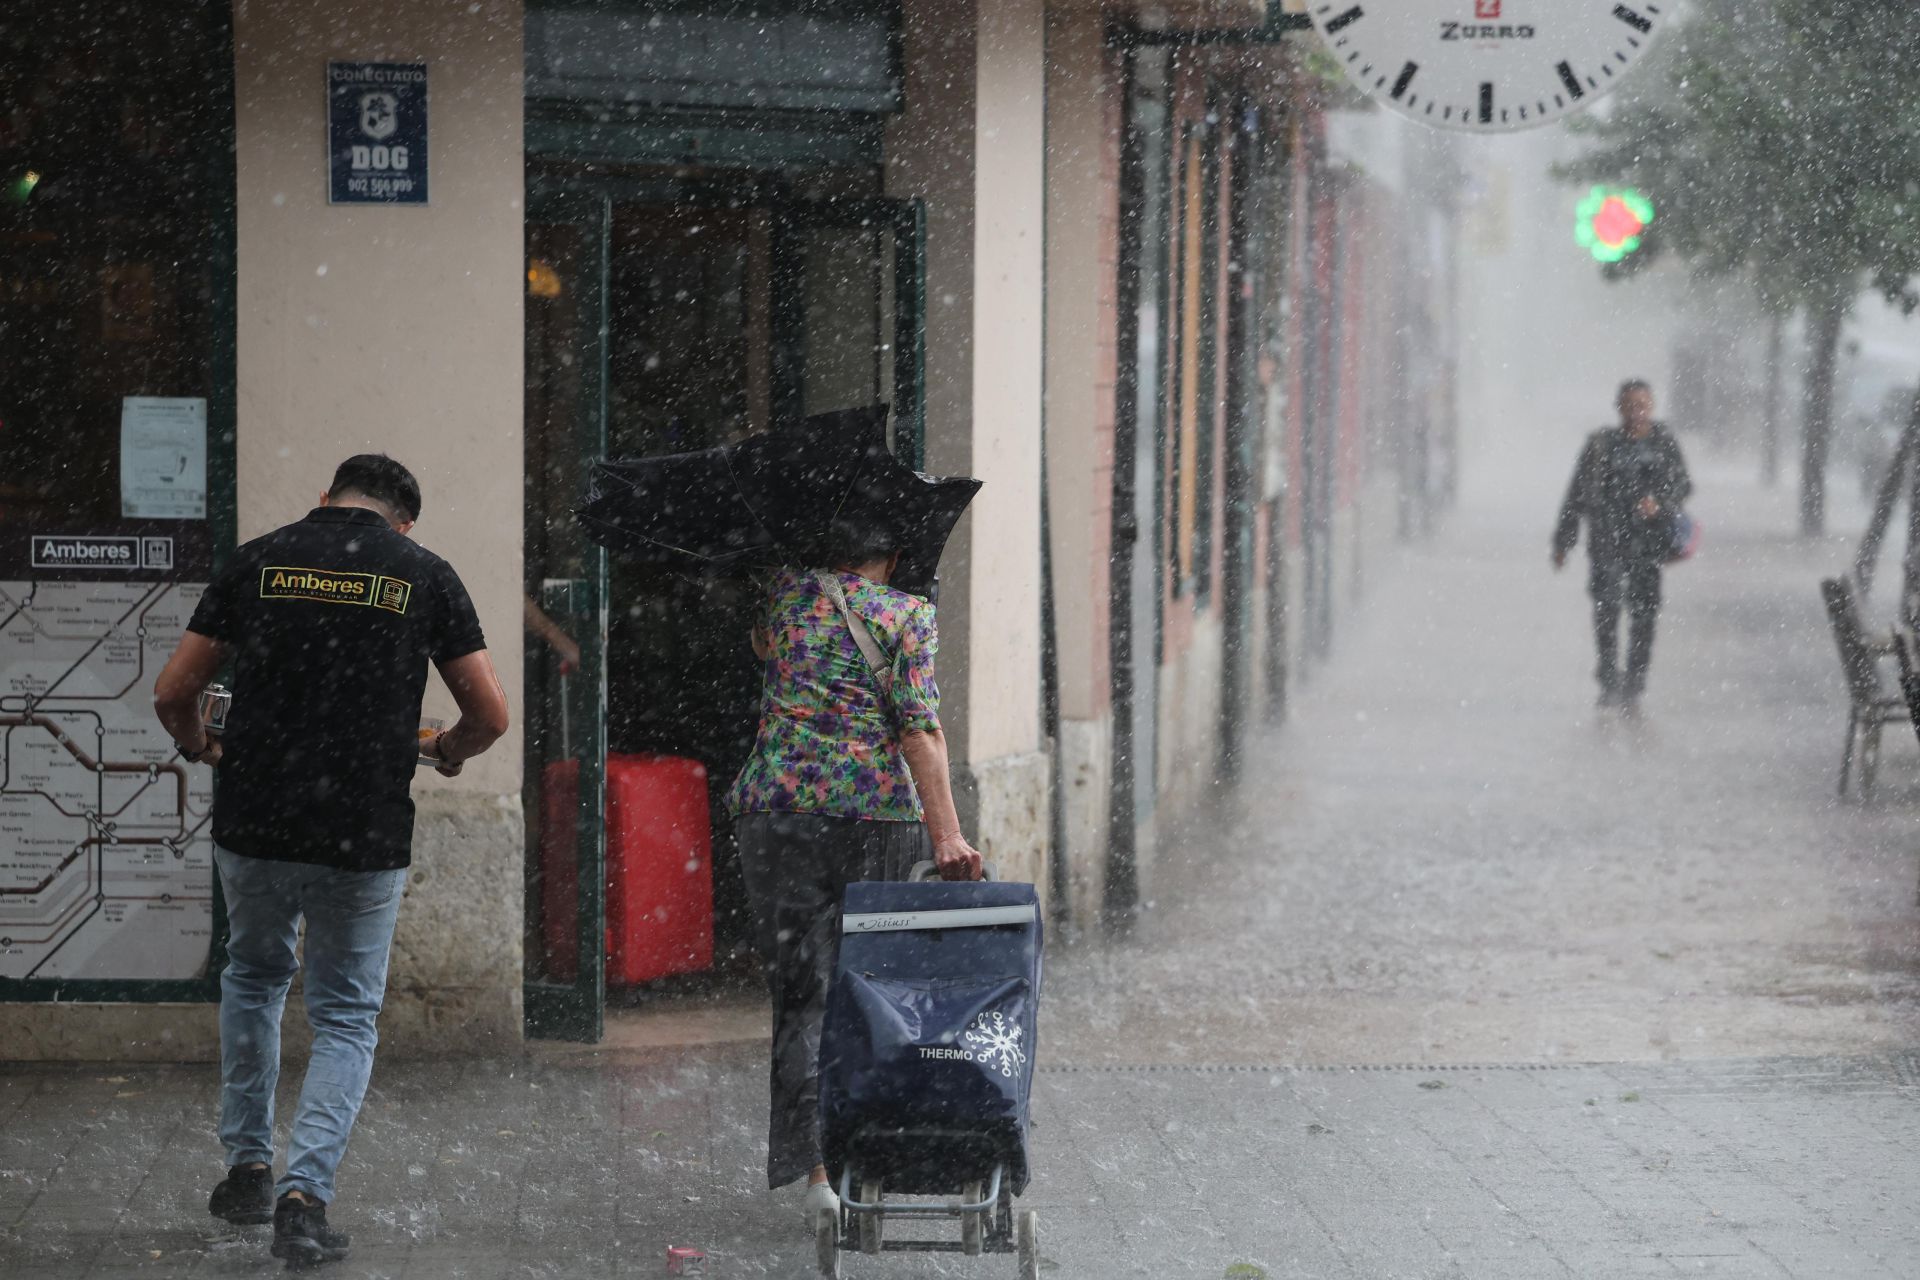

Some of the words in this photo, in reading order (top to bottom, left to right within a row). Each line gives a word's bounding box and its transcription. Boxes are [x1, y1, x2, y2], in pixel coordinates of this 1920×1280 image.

[333, 69, 425, 82] CONECTADO
[351, 145, 409, 170] DOG
[41, 540, 130, 559] Amberes
[271, 571, 365, 594] Amberes
[919, 1047, 973, 1061] THERMO
